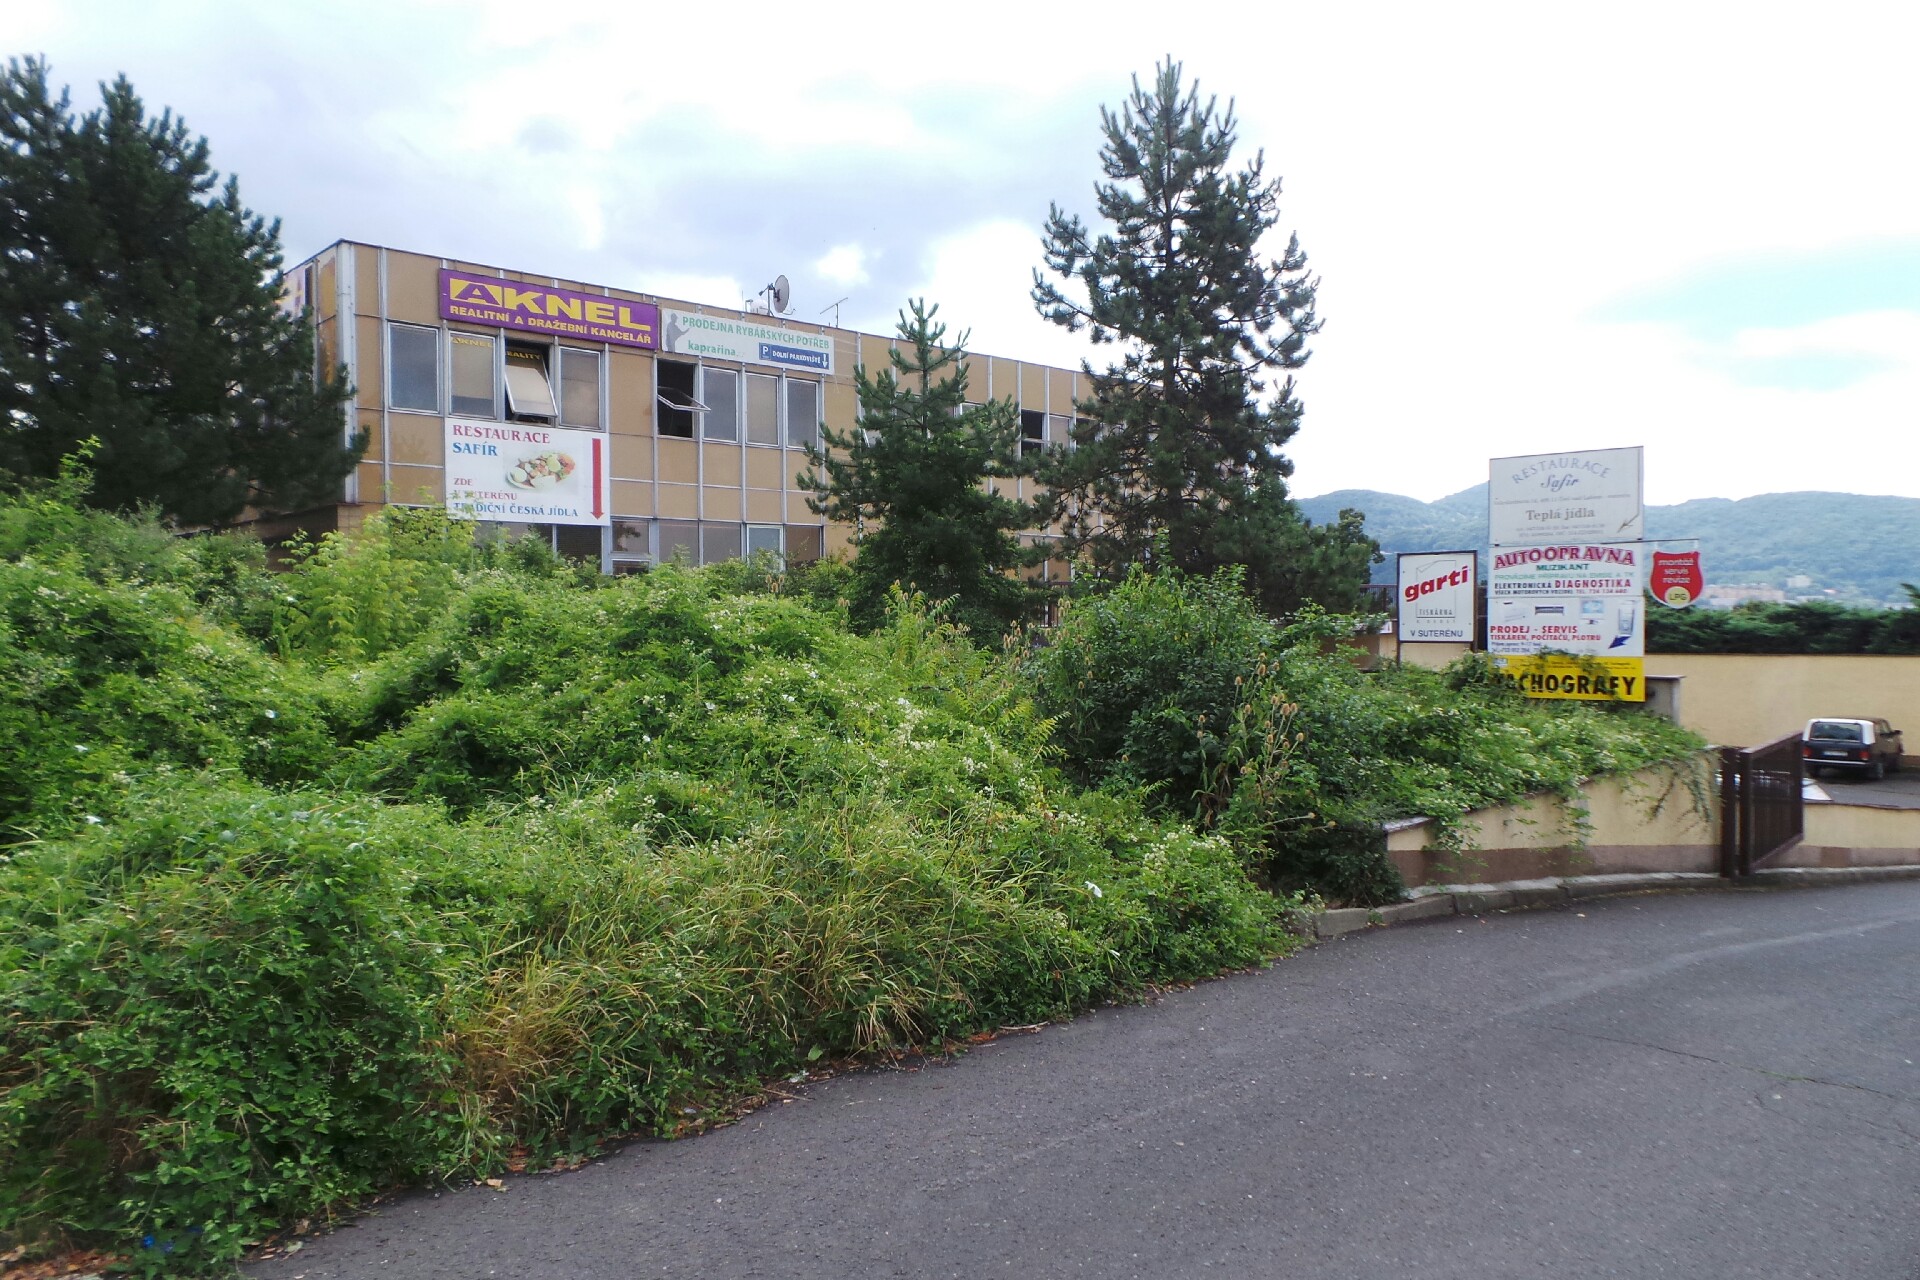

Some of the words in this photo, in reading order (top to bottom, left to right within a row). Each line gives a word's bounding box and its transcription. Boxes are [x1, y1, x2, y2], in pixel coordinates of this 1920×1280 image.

[450, 278, 651, 332] AKNEL
[450, 305, 510, 322] REALITNÍ
[514, 316, 524, 325] A
[527, 316, 588, 334] DRAŽEBNÍ
[591, 327, 651, 344] KANCELÁŘ
[682, 316, 734, 334] PRODEJNA
[736, 324, 795, 344] RYBÁŘSKÝCH
[796, 335, 830, 349] POTŘEB
[772, 350, 788, 360] DOLNÍ
[453, 424, 550, 444] RESTAURACE
[453, 441, 498, 456] SAFÍR
[1511, 457, 1611, 484] RESTAURACE
[454, 477, 472, 486] ZDE
[454, 502, 505, 514] TRDIČNÍ
[509, 502, 545, 516] ČESKÁ
[548, 505, 578, 517] JÍDLA
[1526, 508, 1561, 522] Teplá
[1565, 508, 1596, 521] jídla
[1493, 546, 1636, 570] AUTOOPRAVNA
[1536, 563, 1590, 571] MUZIKANT
[1404, 565, 1468, 602] garti
[1555, 579, 1631, 589] DIAGNOSTIKA
[1490, 625, 1530, 634] PRODEJ
[1542, 625, 1578, 634] SERVIS
[1494, 673, 1637, 696] CHOGRAFY
